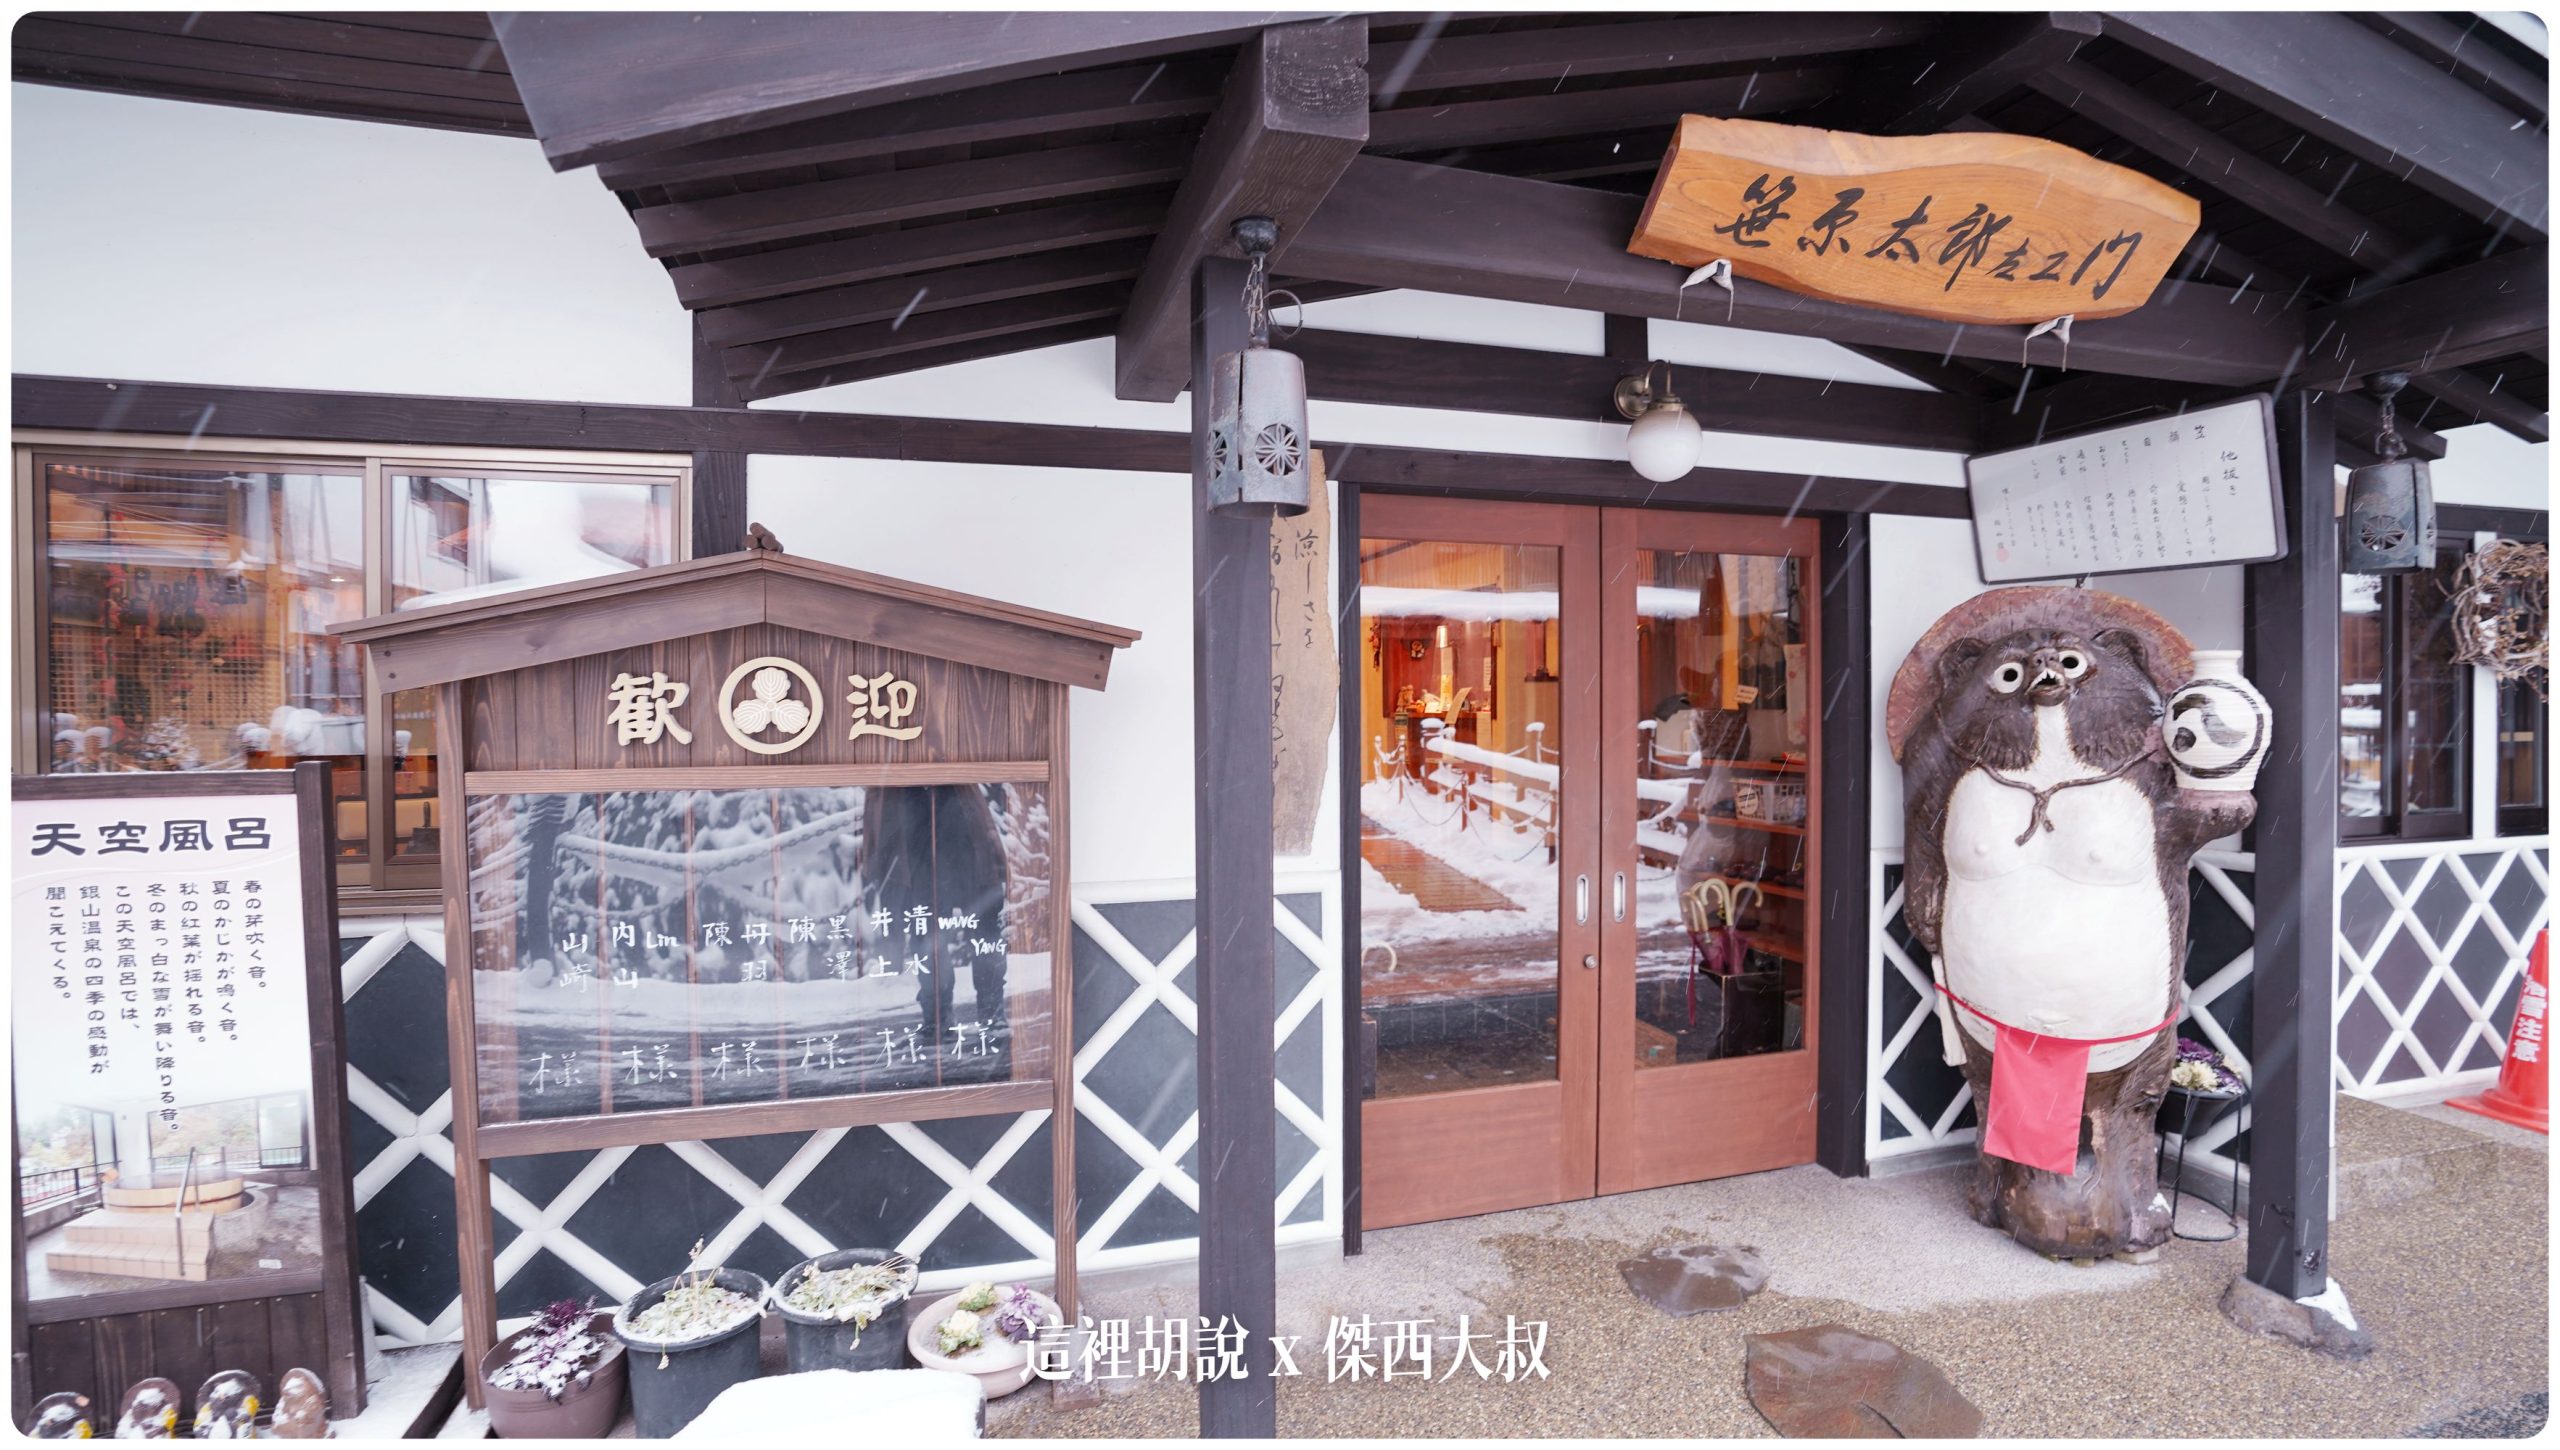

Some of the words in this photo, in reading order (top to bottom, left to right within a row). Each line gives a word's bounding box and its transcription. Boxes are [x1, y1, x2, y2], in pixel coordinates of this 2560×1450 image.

[30, 817, 272, 857] 天空風呂
[44, 885, 72, 1000] 聞こえてくる。
[79, 884, 111, 1075] 銀山温泉の四季の感動が
[115, 884, 141, 1030] この天空風呂では、
[178, 881, 207, 1043] 秋の紅葉が揺れる音。
[211, 879, 238, 1041] 夏のかじかが鳴く音。
[242, 879, 268, 988] 春の芽吹く音。
[645, 930, 681, 950] Lin
[937, 912, 981, 931] WANG
[970, 937, 1008, 957] YANG
[145, 882, 179, 1131] 冬のまっ白な雪が舞い降りる音。
